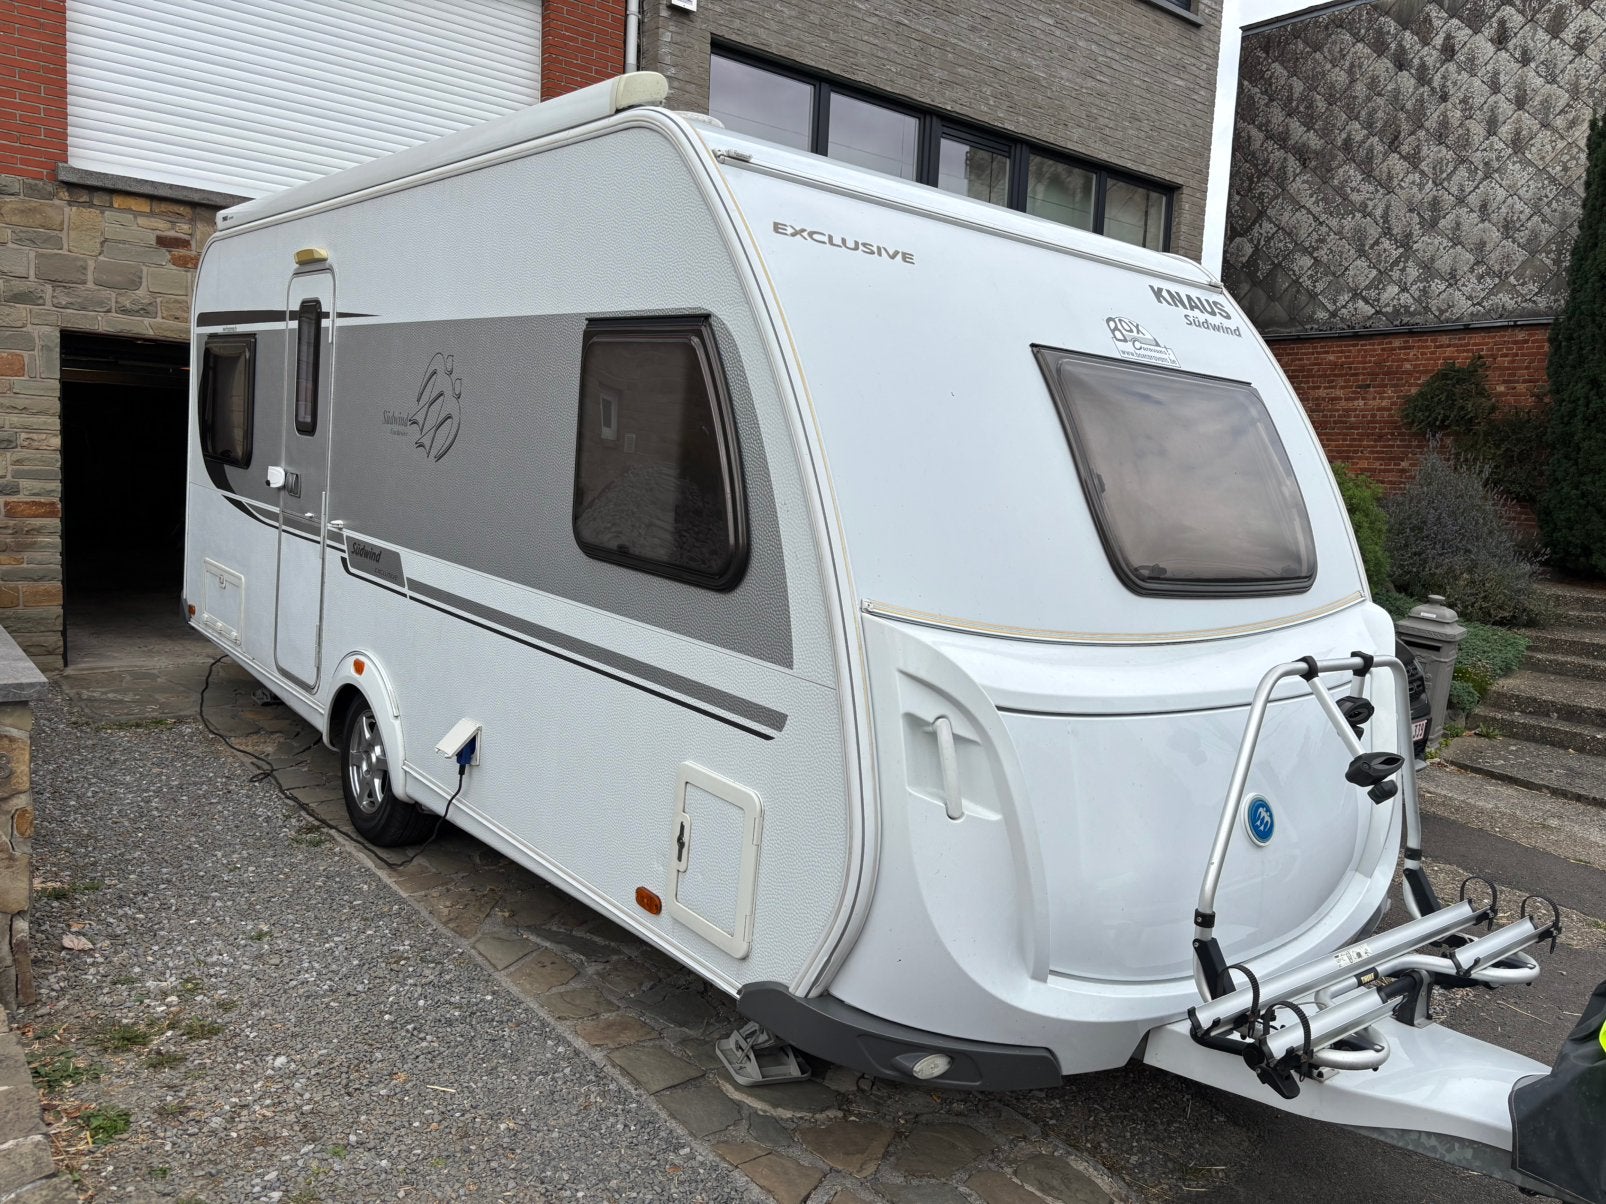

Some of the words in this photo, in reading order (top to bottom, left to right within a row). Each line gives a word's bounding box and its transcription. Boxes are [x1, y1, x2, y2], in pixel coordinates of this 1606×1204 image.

[773, 221, 915, 265] EXCLUSIVE
[1148, 284, 1232, 320] KNAUS
[1183, 313, 1242, 338] Südwind
[351, 542, 382, 563] Südwind
